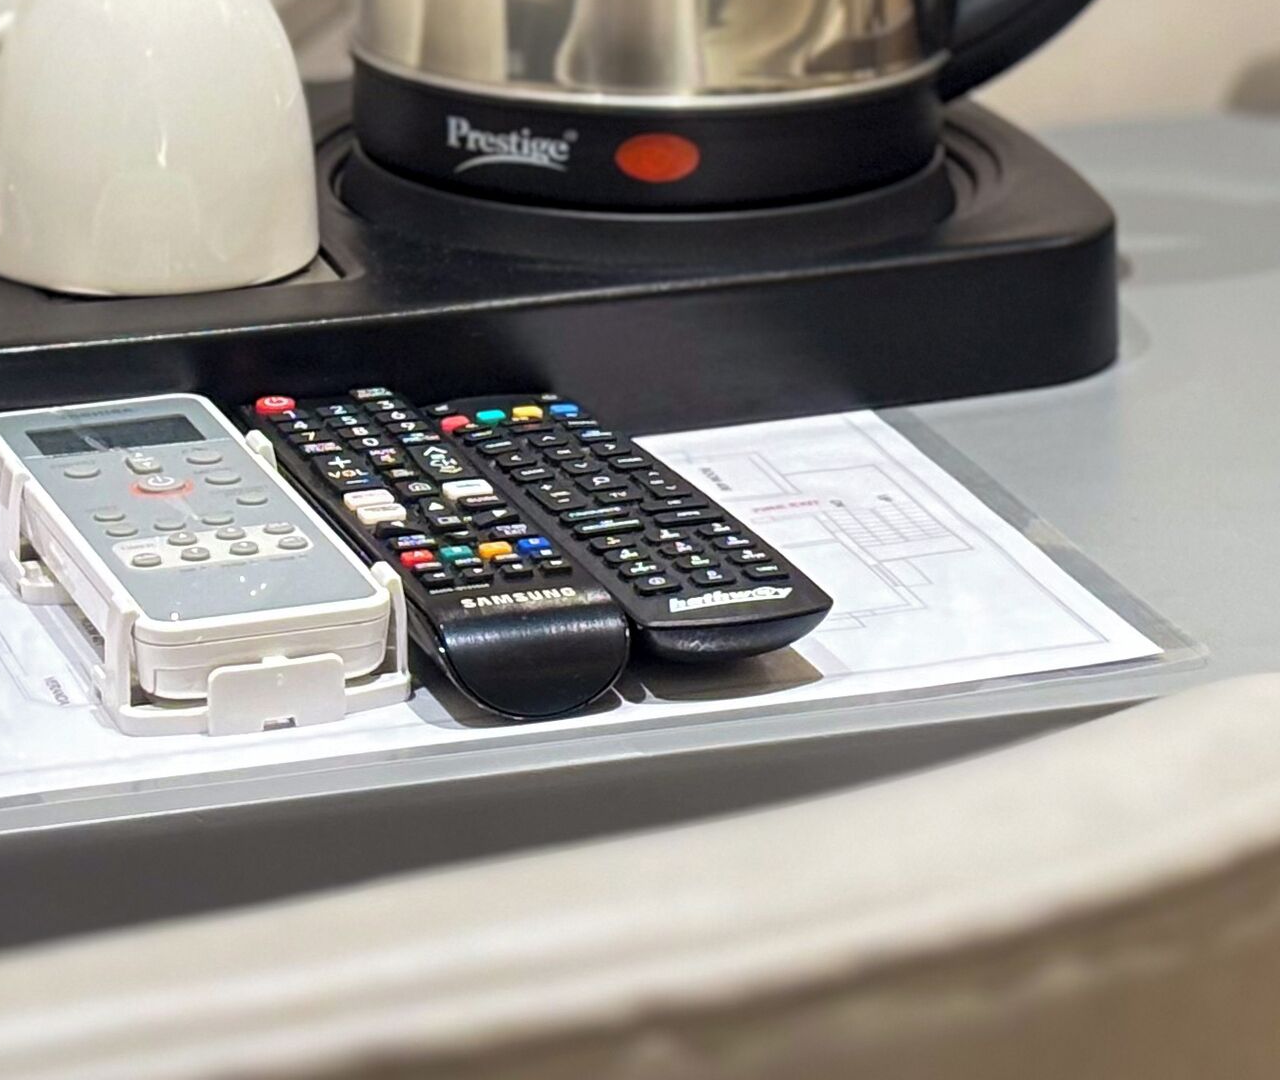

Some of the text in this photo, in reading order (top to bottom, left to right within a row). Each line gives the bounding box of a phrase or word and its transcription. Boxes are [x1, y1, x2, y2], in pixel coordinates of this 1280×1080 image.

[447, 115, 570, 164] Prestige
[329, 405, 347, 415] 2
[377, 400, 395, 410] 3
[283, 410, 296, 419] 1
[391, 410, 406, 420] 6
[293, 420, 308, 430] 4
[340, 415, 358, 425] 5
[351, 426, 369, 436] 8
[400, 421, 416, 431] 9
[301, 431, 316, 441] 7
[362, 437, 379, 447] 0
[327, 468, 369, 479] VOL
[460, 586, 578, 609] SAMSUNG
[669, 586, 793, 614] hathway
